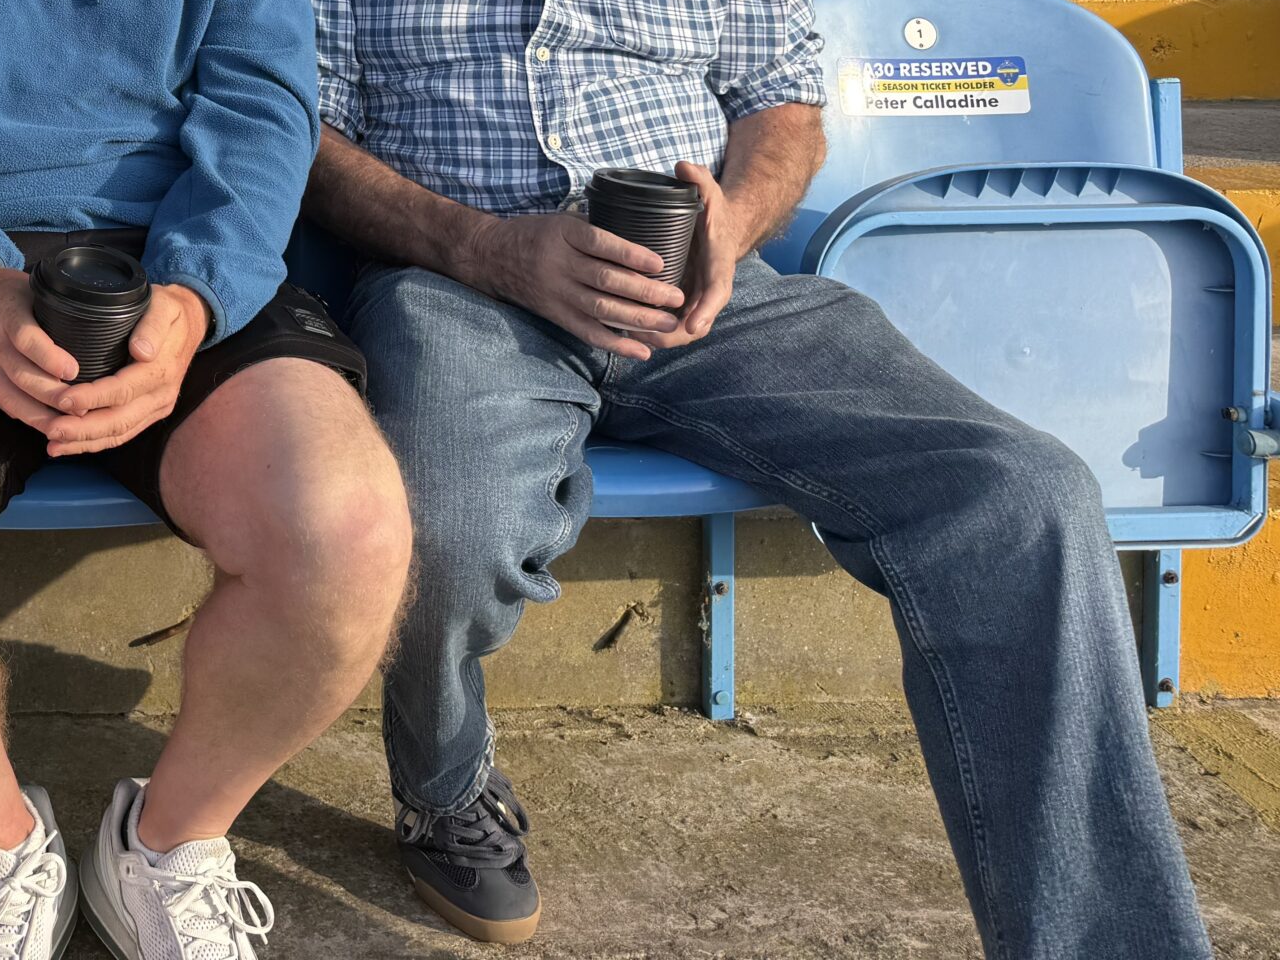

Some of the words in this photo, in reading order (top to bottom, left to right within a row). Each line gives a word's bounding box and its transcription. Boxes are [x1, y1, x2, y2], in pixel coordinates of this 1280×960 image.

[916, 29, 923, 39] 1
[863, 61, 894, 78] A30
[899, 61, 992, 78] RESERVED
[882, 82, 919, 91] SEASON
[921, 82, 952, 91] TICKET
[954, 81, 995, 90] HOLDER
[866, 96, 907, 110] Peter
[912, 94, 999, 110] Calladine
